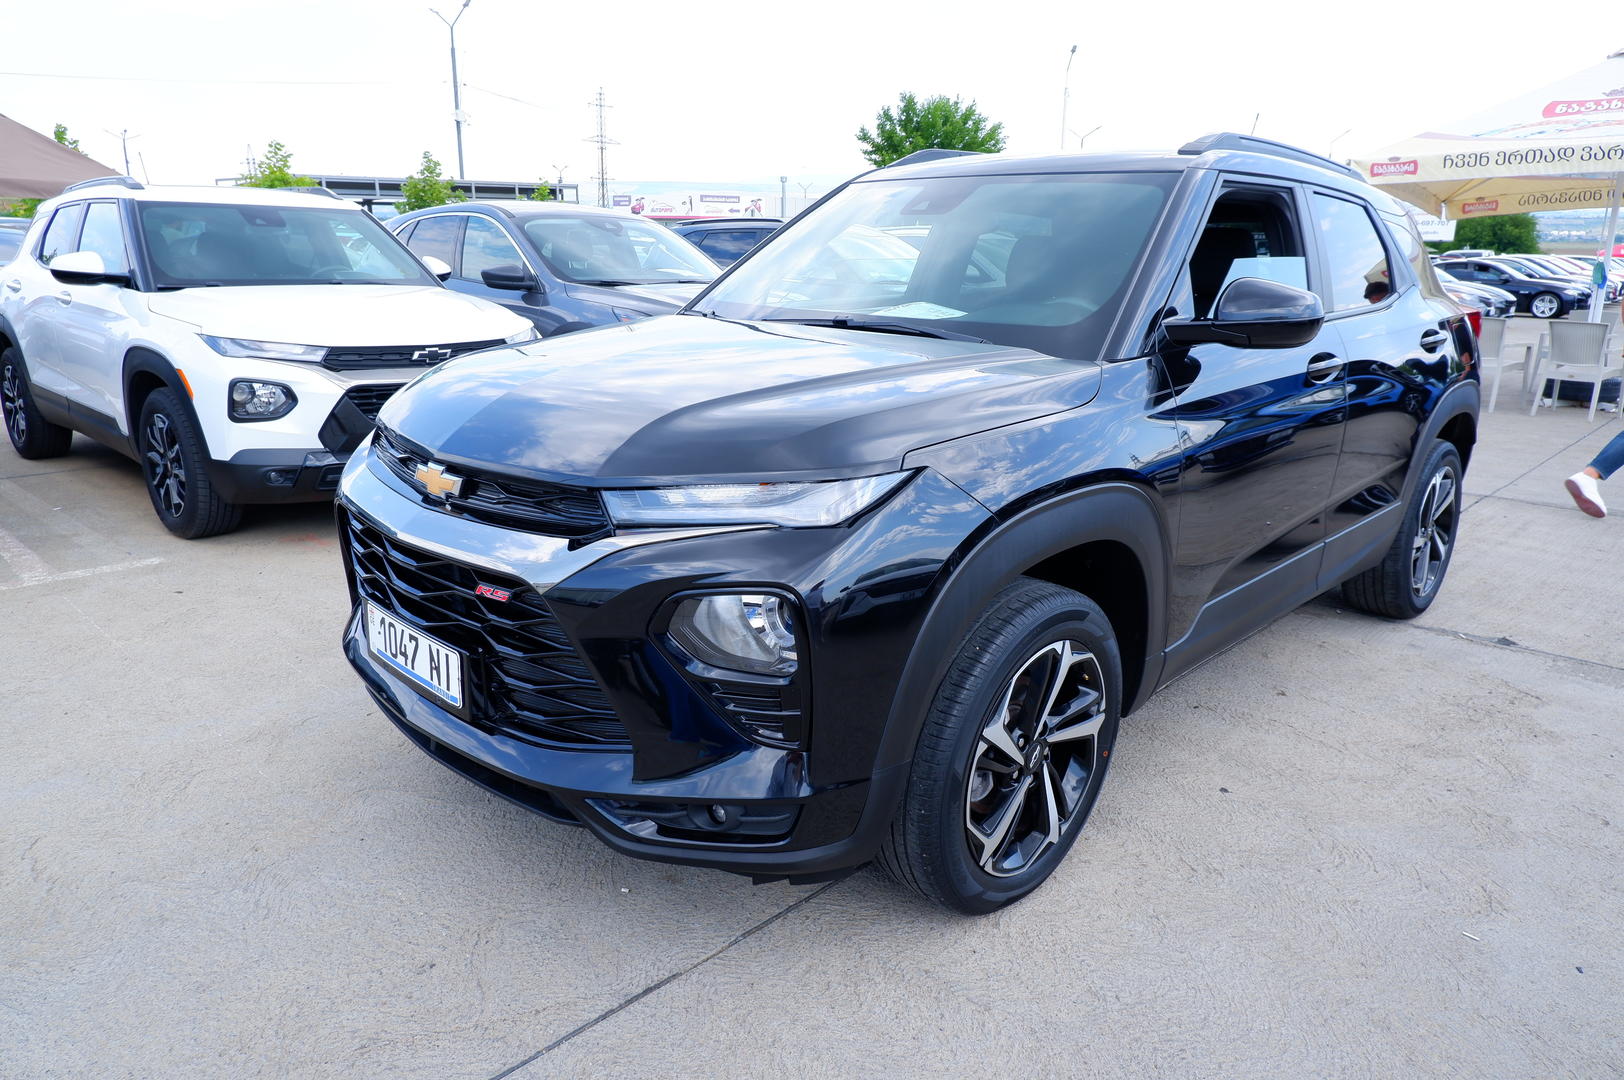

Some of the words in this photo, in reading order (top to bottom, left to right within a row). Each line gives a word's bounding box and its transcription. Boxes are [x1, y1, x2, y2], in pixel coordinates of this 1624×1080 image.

[1554, 99, 1624, 114] ნატახ
[1443, 152, 1490, 169] ჩვენ
[1495, 146, 1575, 166] ერთად
[475, 584, 511, 602] RS
[379, 616, 419, 671] 1047
